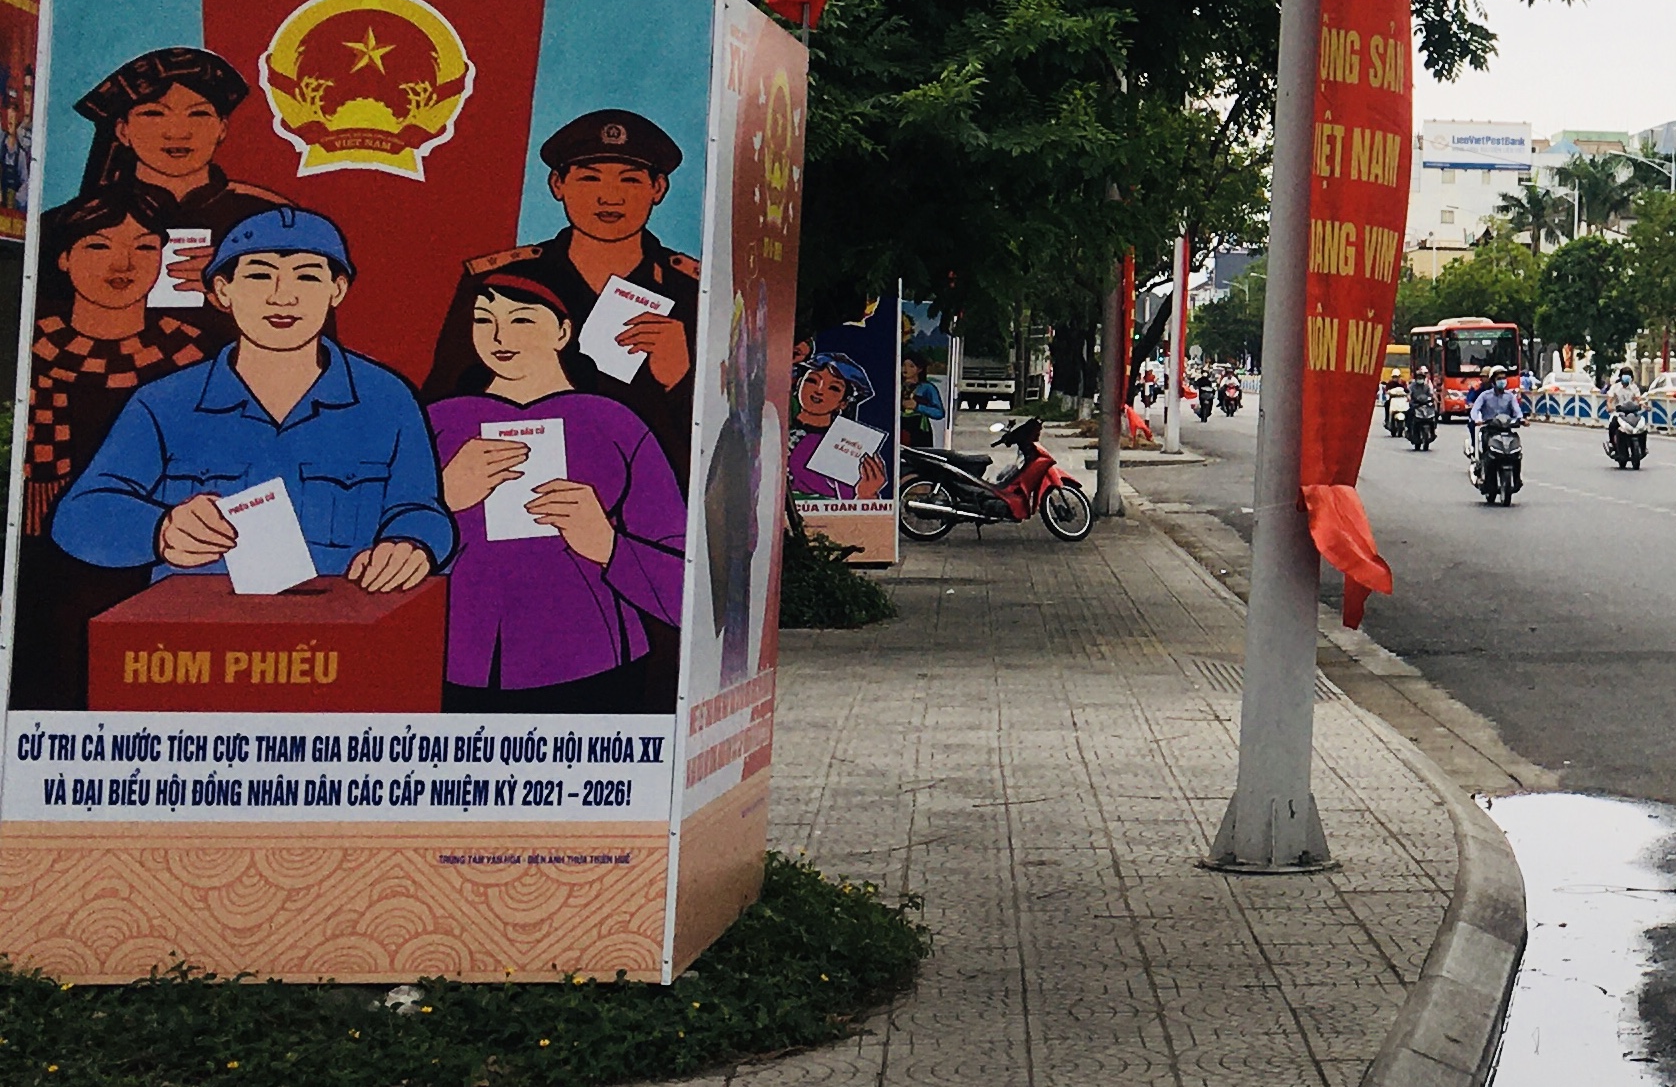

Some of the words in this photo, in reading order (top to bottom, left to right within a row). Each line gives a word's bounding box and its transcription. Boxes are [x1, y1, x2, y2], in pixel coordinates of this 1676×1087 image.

[1320, 14, 1361, 92] ỘNG
[1312, 110, 1345, 190] IỆT
[1350, 127, 1401, 188] NAM
[124, 642, 212, 684] HÒM
[224, 639, 339, 684] PHIẾU
[17, 722, 46, 761] CỬ
[48, 734, 77, 761] TRI
[81, 723, 106, 762] CẢ
[111, 727, 162, 762] NƯỚC
[167, 729, 208, 762] TÍCH
[213, 732, 250, 768] CỰC
[255, 735, 307, 763] THAM
[311, 735, 342, 763] GIA
[347, 726, 384, 763] BẦU
[389, 724, 417, 763] CỬ
[417, 735, 449, 768] ĐẠI
[454, 725, 495, 763] BIỂU
[500, 726, 548, 766] QUỐC
[552, 730, 583, 769] HỘI
[587, 730, 635, 763] KHÓA
[636, 736, 666, 763] XV
[43, 773, 67, 806] VÀ
[72, 778, 103, 811] ĐẠI
[108, 768, 151, 806] BIỂU
[155, 773, 187, 812] HỘI
[192, 770, 242, 806] ĐỒNG
[247, 773, 299, 806] NHÂN
[303, 773, 342, 806] DÂN
[347, 773, 384, 806] CÁC
[388, 769, 426, 806] CẤP
[430, 773, 490, 812] NHIỆM
[494, 773, 518, 806] KỲ
[521, 779, 564, 806] 2021
[582, 779, 632, 806] 2026!
